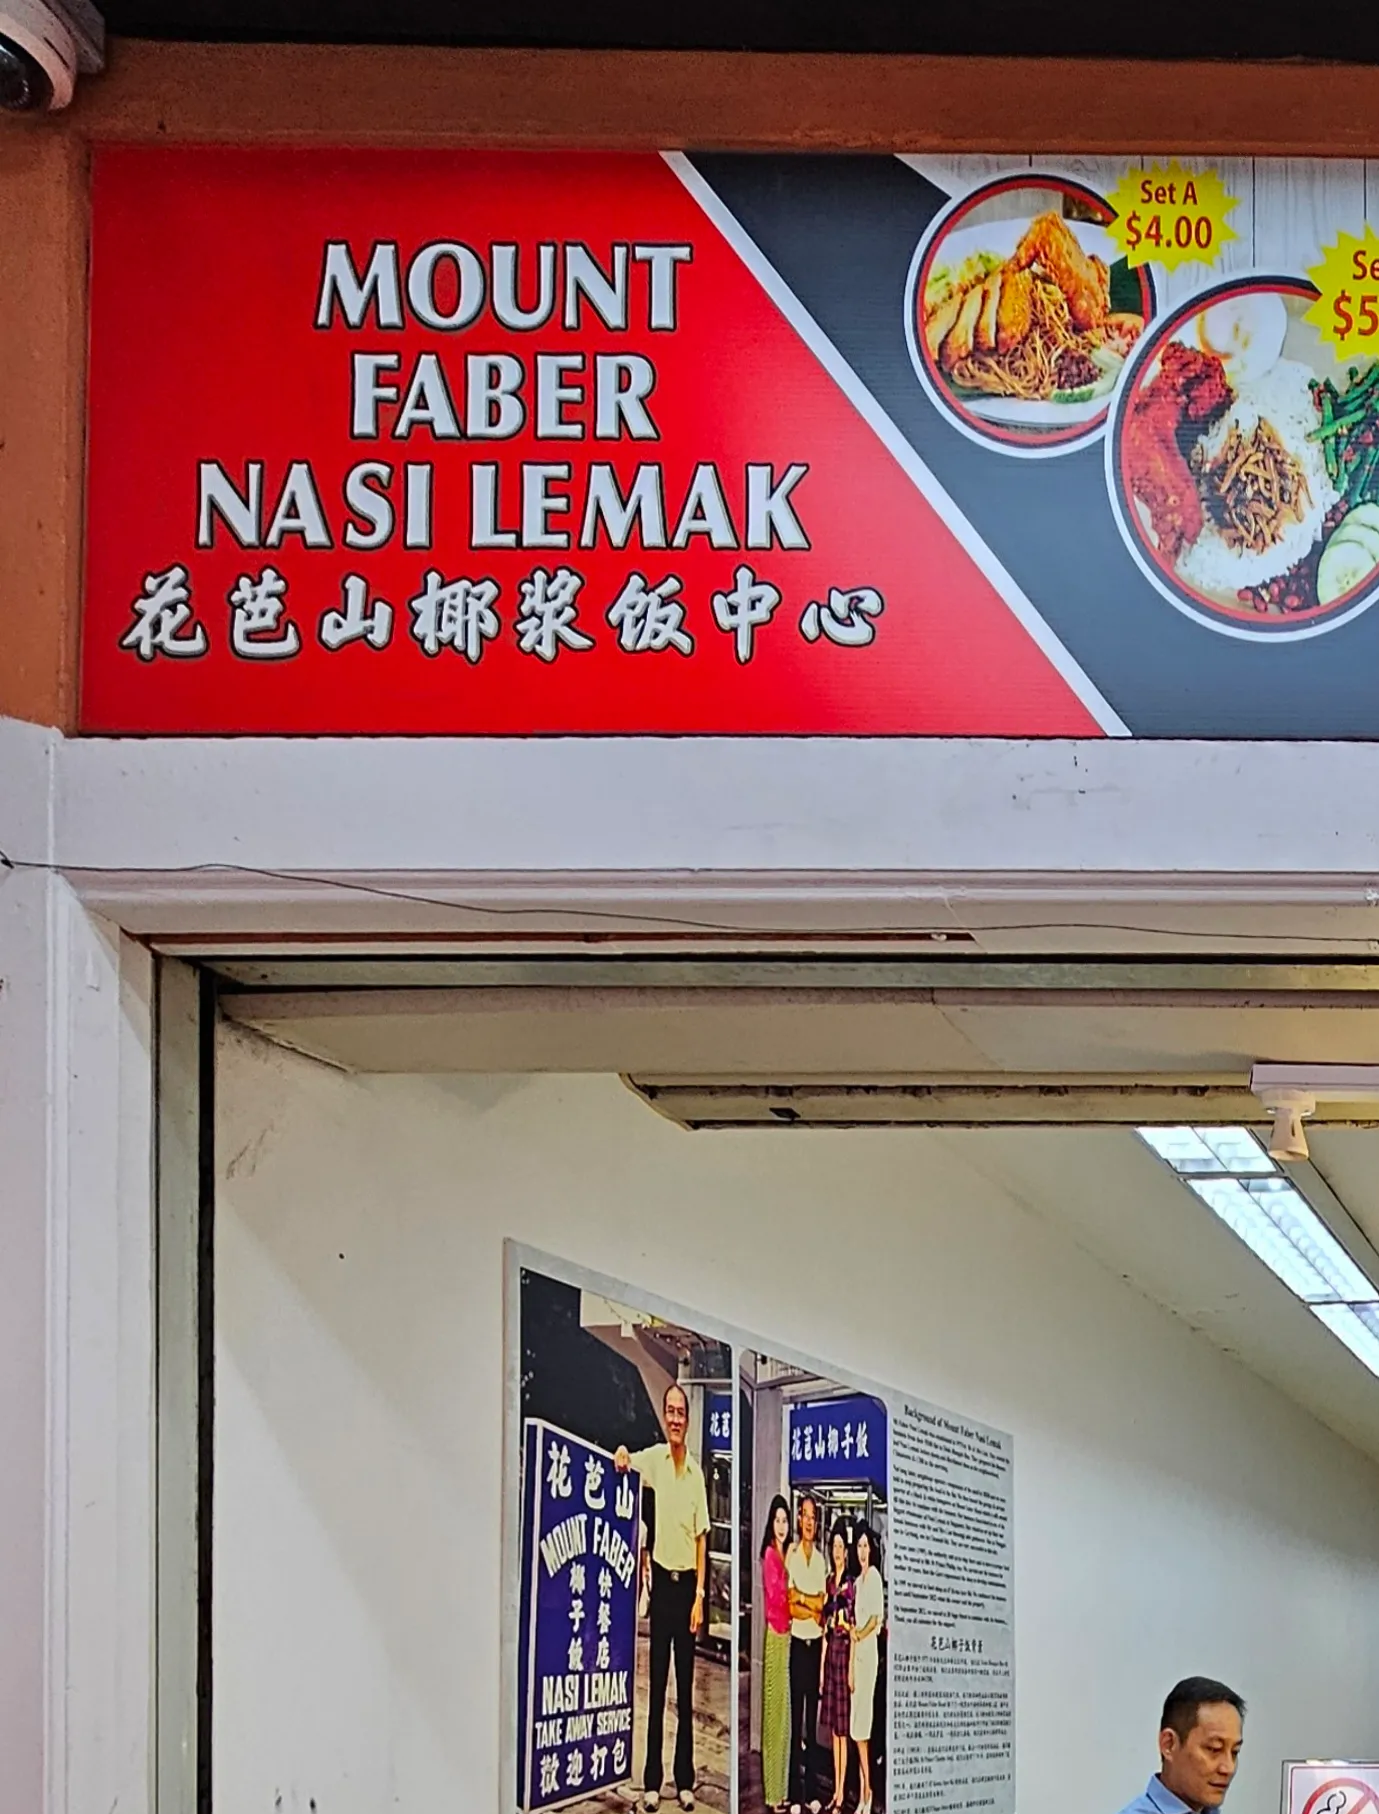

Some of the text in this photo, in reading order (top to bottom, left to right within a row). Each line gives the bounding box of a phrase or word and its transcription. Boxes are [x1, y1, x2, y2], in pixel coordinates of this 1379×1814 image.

[1125, 213, 1212, 252] $4.00
[1140, 181, 1199, 207] Set A
[315, 241, 694, 333] MOUNT
[351, 354, 659, 441] FABER
[198, 461, 811, 552] NASI LEMAK
[120, 565, 885, 666] 花芭山椰浆饭中心
[546, 1440, 634, 1520] 花芭山
[540, 1512, 635, 1589] MOUNT FABER
[535, 1707, 632, 1750] TAKE AWAY SERVICE
[541, 1670, 628, 1716] NASI LEMAK
